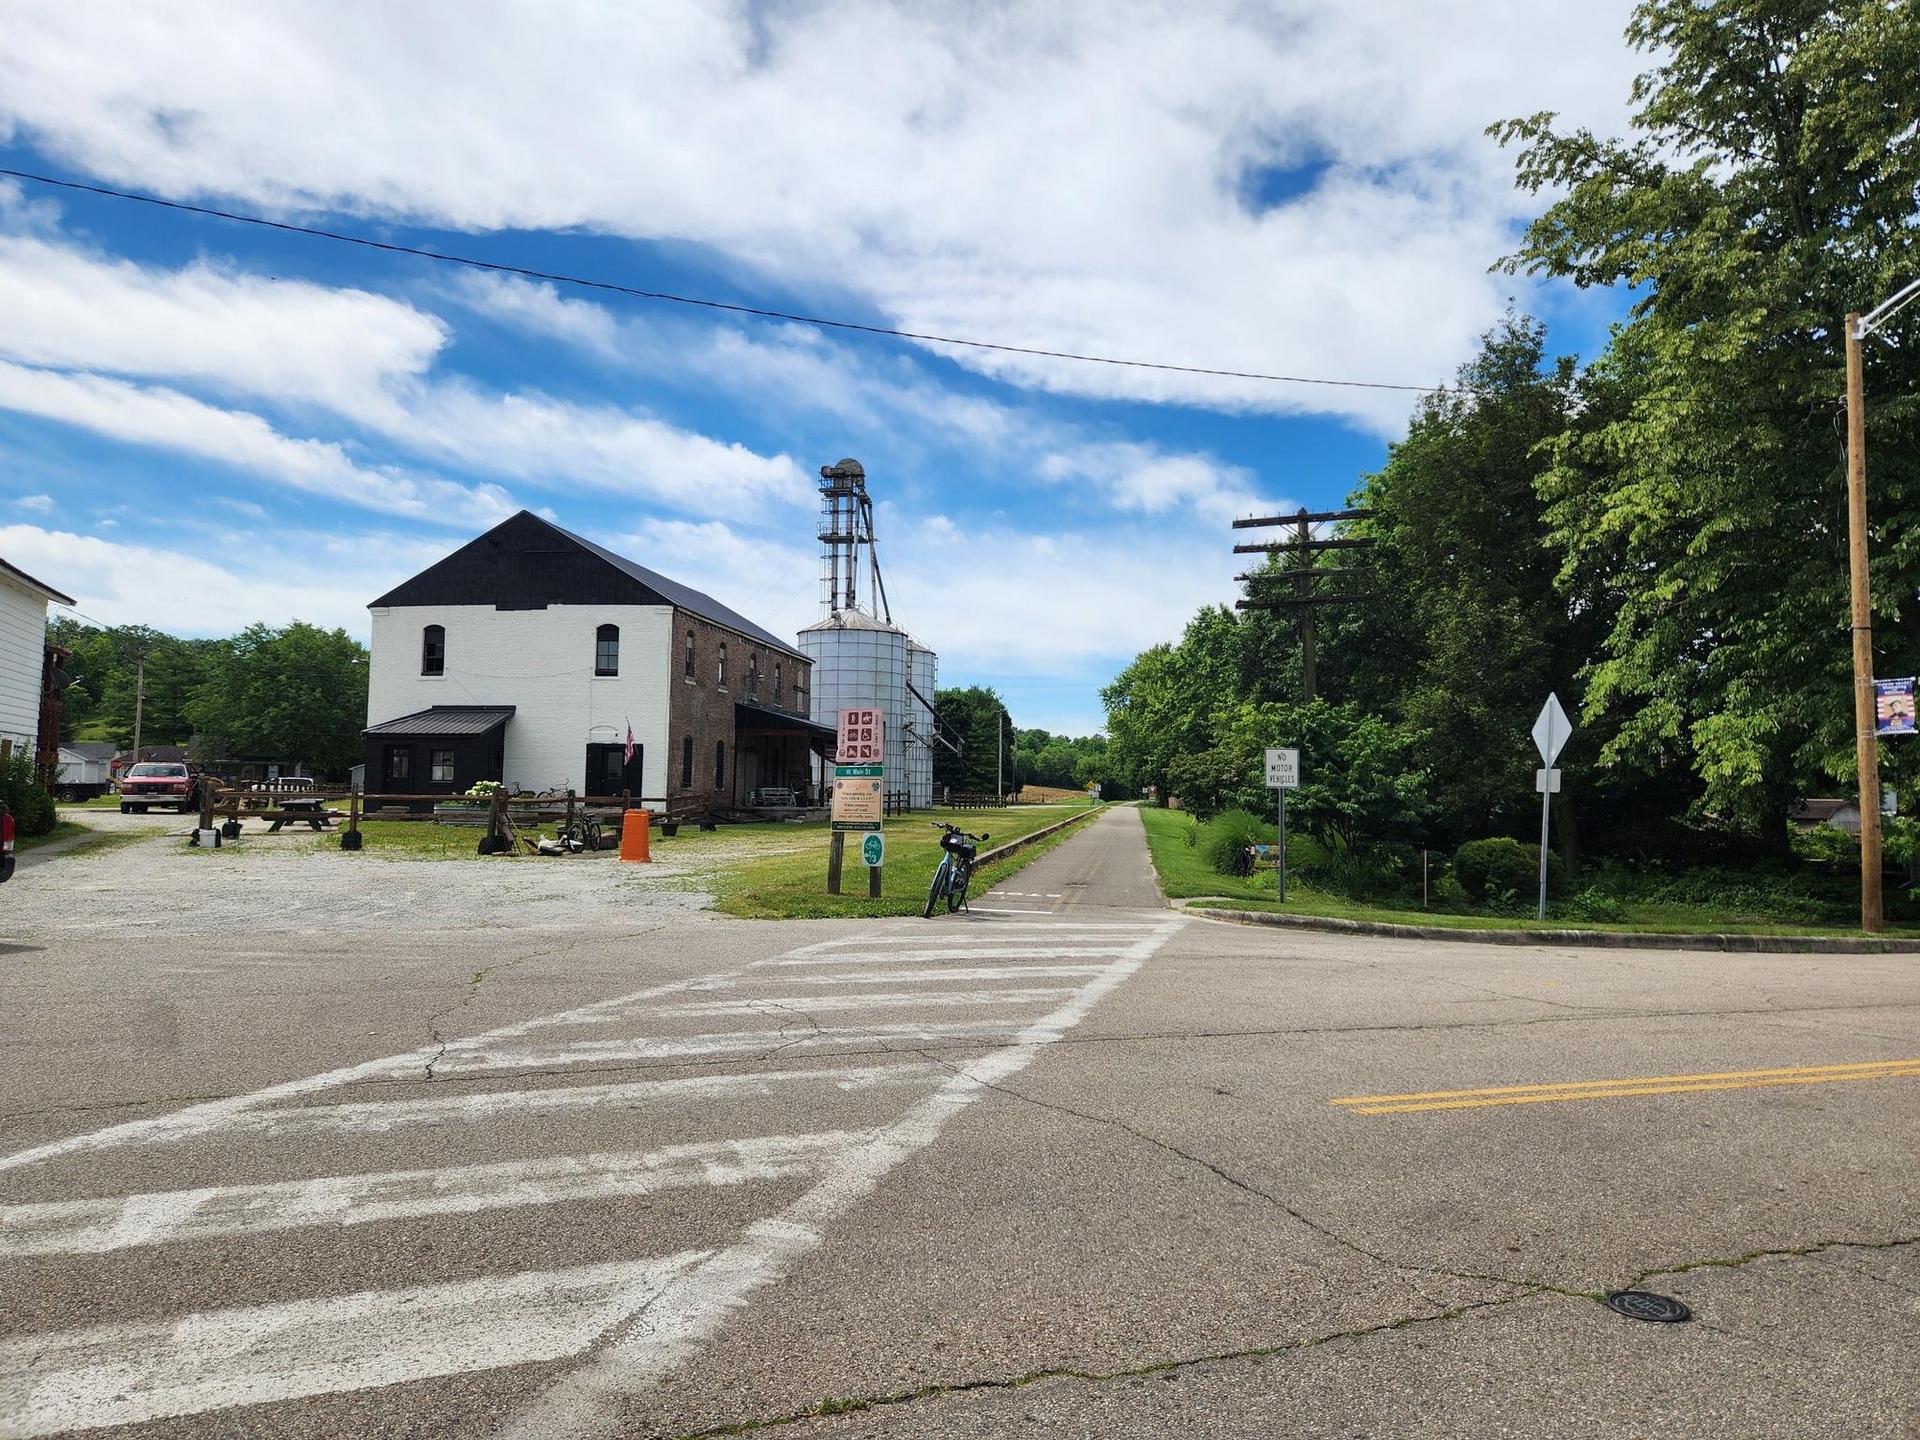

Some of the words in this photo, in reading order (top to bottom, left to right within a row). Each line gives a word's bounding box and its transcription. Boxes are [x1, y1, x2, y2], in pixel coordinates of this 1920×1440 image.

[1277, 753, 1286, 761] NO
[864, 767, 871, 775] St
[1271, 764, 1293, 772] MOTOR
[1269, 775, 1295, 784] VEHICLES
